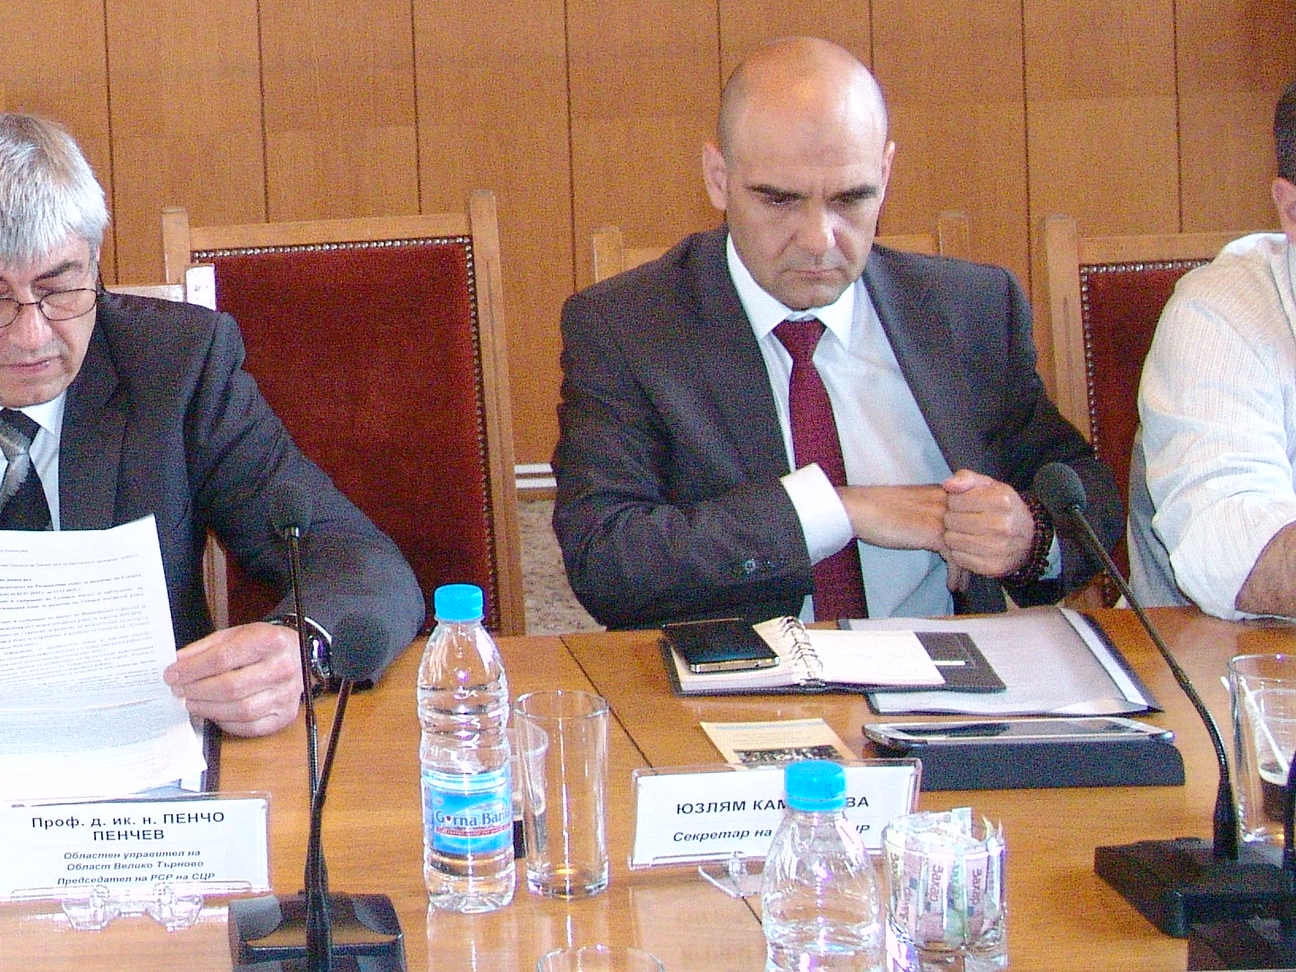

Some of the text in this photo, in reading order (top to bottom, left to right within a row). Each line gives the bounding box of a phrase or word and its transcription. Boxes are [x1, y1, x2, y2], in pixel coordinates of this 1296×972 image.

[676, 796, 869, 815] ЮЗЛЯМ КАМВА
[32, 812, 225, 830] Проф. д. ик. н. ПЕНЧО
[93, 829, 165, 841] ПЕНЧЕВ
[673, 829, 773, 842] Секретар на
[63, 851, 121, 860] Областен
[67, 860, 204, 871] Област Велико Търново
[57, 875, 132, 887] Председател
